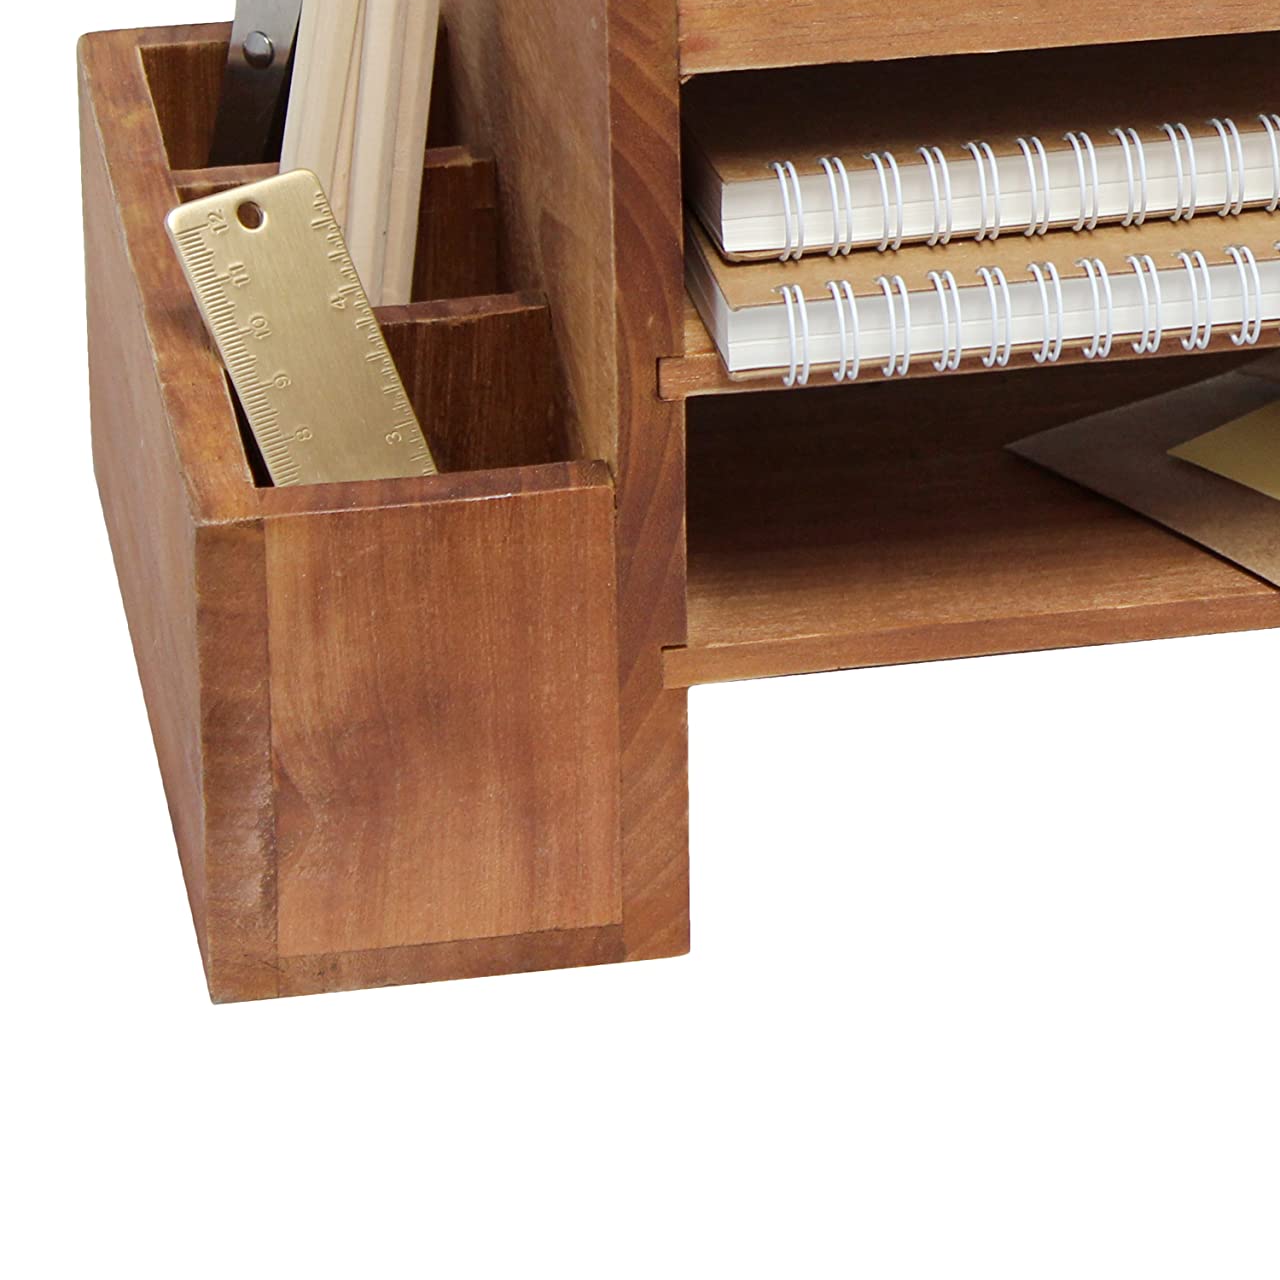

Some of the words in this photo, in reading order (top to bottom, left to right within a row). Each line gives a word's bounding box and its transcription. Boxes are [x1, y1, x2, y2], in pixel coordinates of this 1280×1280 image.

[207, 209, 229, 234] 12
[227, 261, 250, 287] 11
[330, 295, 346, 309] 4
[248, 315, 272, 340] 10
[295, 426, 313, 441] 8
[385, 432, 402, 446] 3
